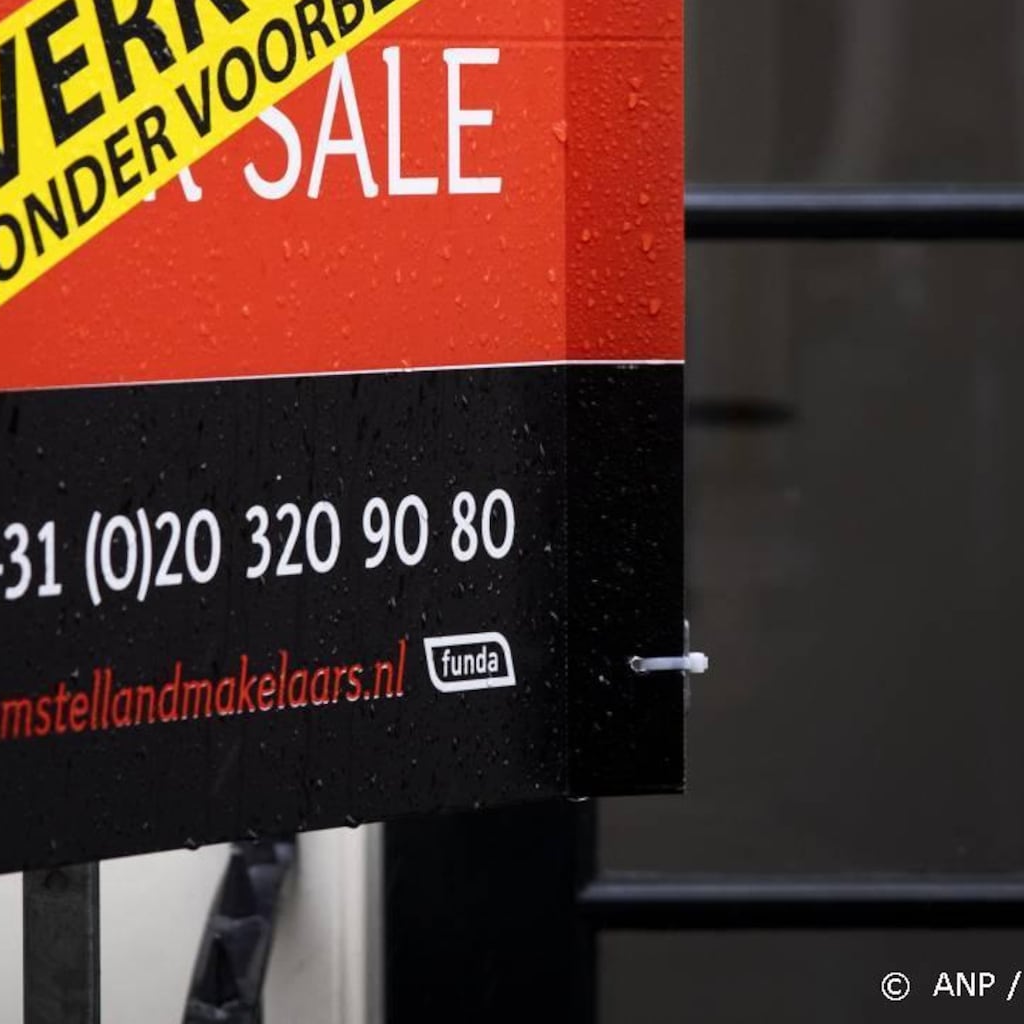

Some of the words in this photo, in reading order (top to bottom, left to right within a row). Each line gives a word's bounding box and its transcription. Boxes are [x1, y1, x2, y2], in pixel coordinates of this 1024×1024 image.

[243, 46, 502, 201] SALE
[85, 507, 221, 606] (0)20
[246, 500, 341, 578] 320
[362, 494, 429, 568] 90
[451, 488, 516, 561] 80
[441, 646, 500, 678] funda
